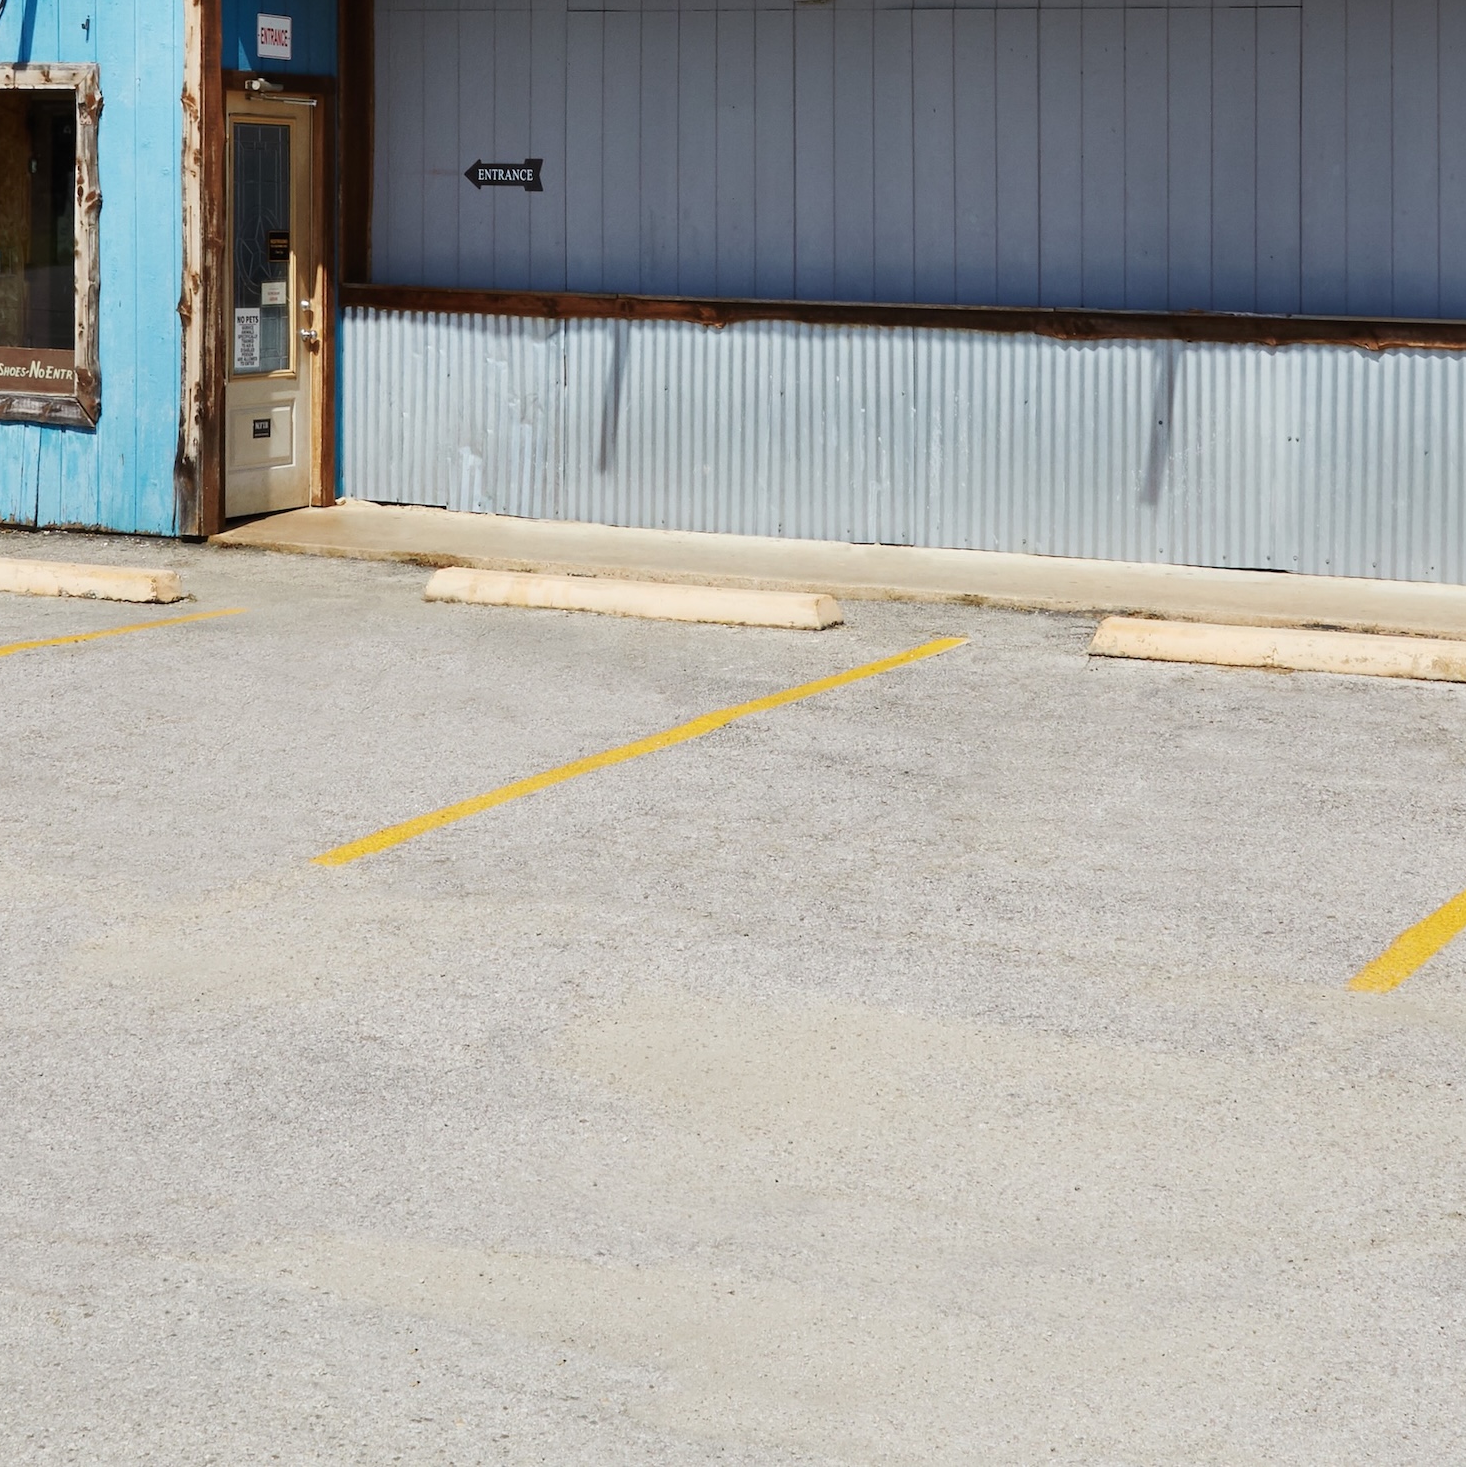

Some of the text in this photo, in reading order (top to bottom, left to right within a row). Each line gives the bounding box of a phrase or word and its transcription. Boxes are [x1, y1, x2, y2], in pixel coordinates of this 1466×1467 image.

[261, 27, 288, 47] ENTRANCE
[478, 168, 533, 181] ENTRANCE
[237, 315, 259, 324] NO PETS
[45, 366, 74, 380] ENTR
